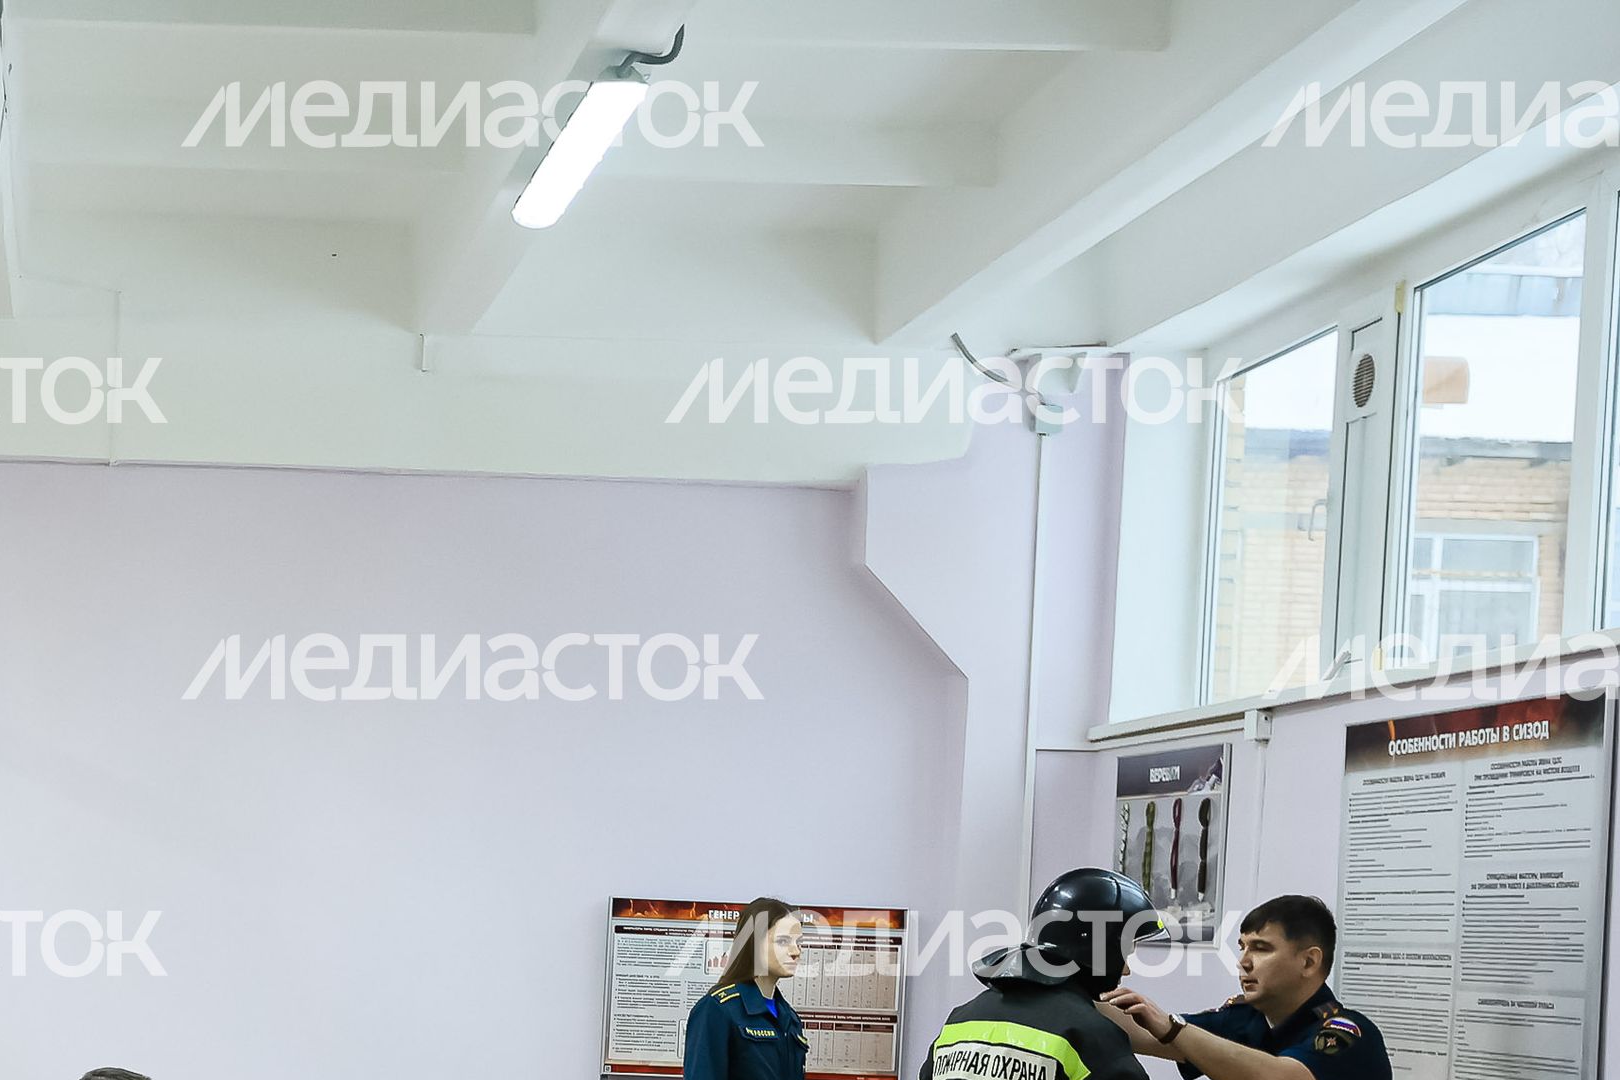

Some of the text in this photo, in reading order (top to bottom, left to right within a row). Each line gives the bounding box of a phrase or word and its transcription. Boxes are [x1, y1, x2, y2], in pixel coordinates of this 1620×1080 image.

[1388, 720, 1549, 756] ОСОБЕННОСТИ РАБОТЫ В СИЗОД
[708, 909, 740, 920] ГЕНЕР
